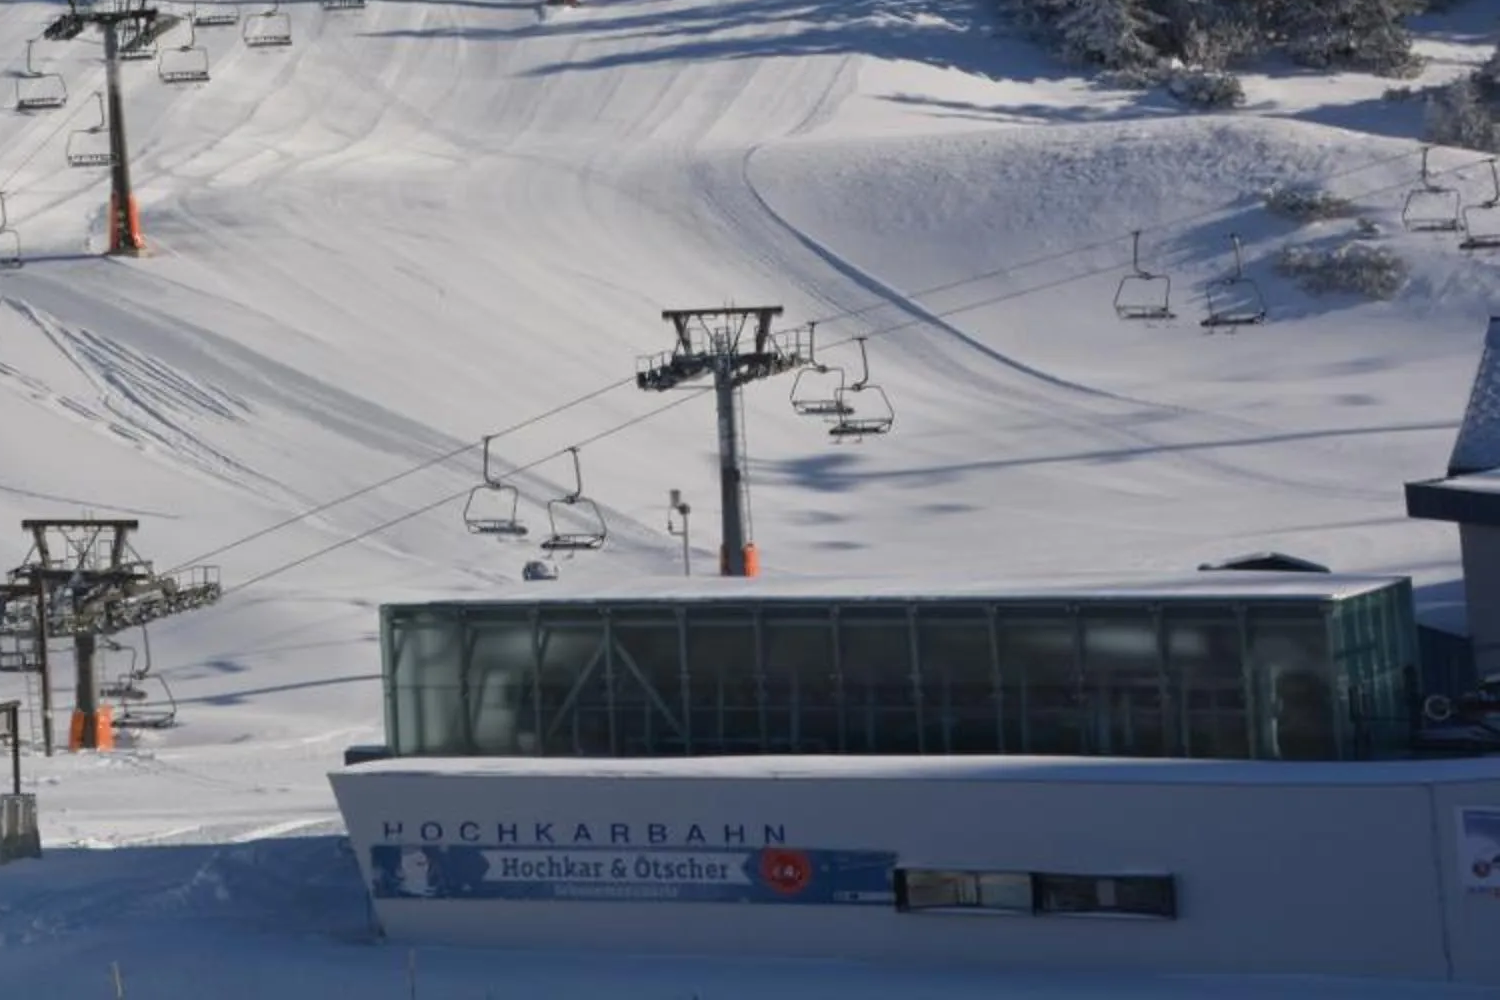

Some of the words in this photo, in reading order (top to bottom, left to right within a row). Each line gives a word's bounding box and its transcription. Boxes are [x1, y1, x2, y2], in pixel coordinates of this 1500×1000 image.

[383, 821, 787, 844] HOCHKARBAHN
[501, 855, 604, 879] Hochkar
[611, 857, 627, 878] &
[634, 854, 731, 880] Ötscher
